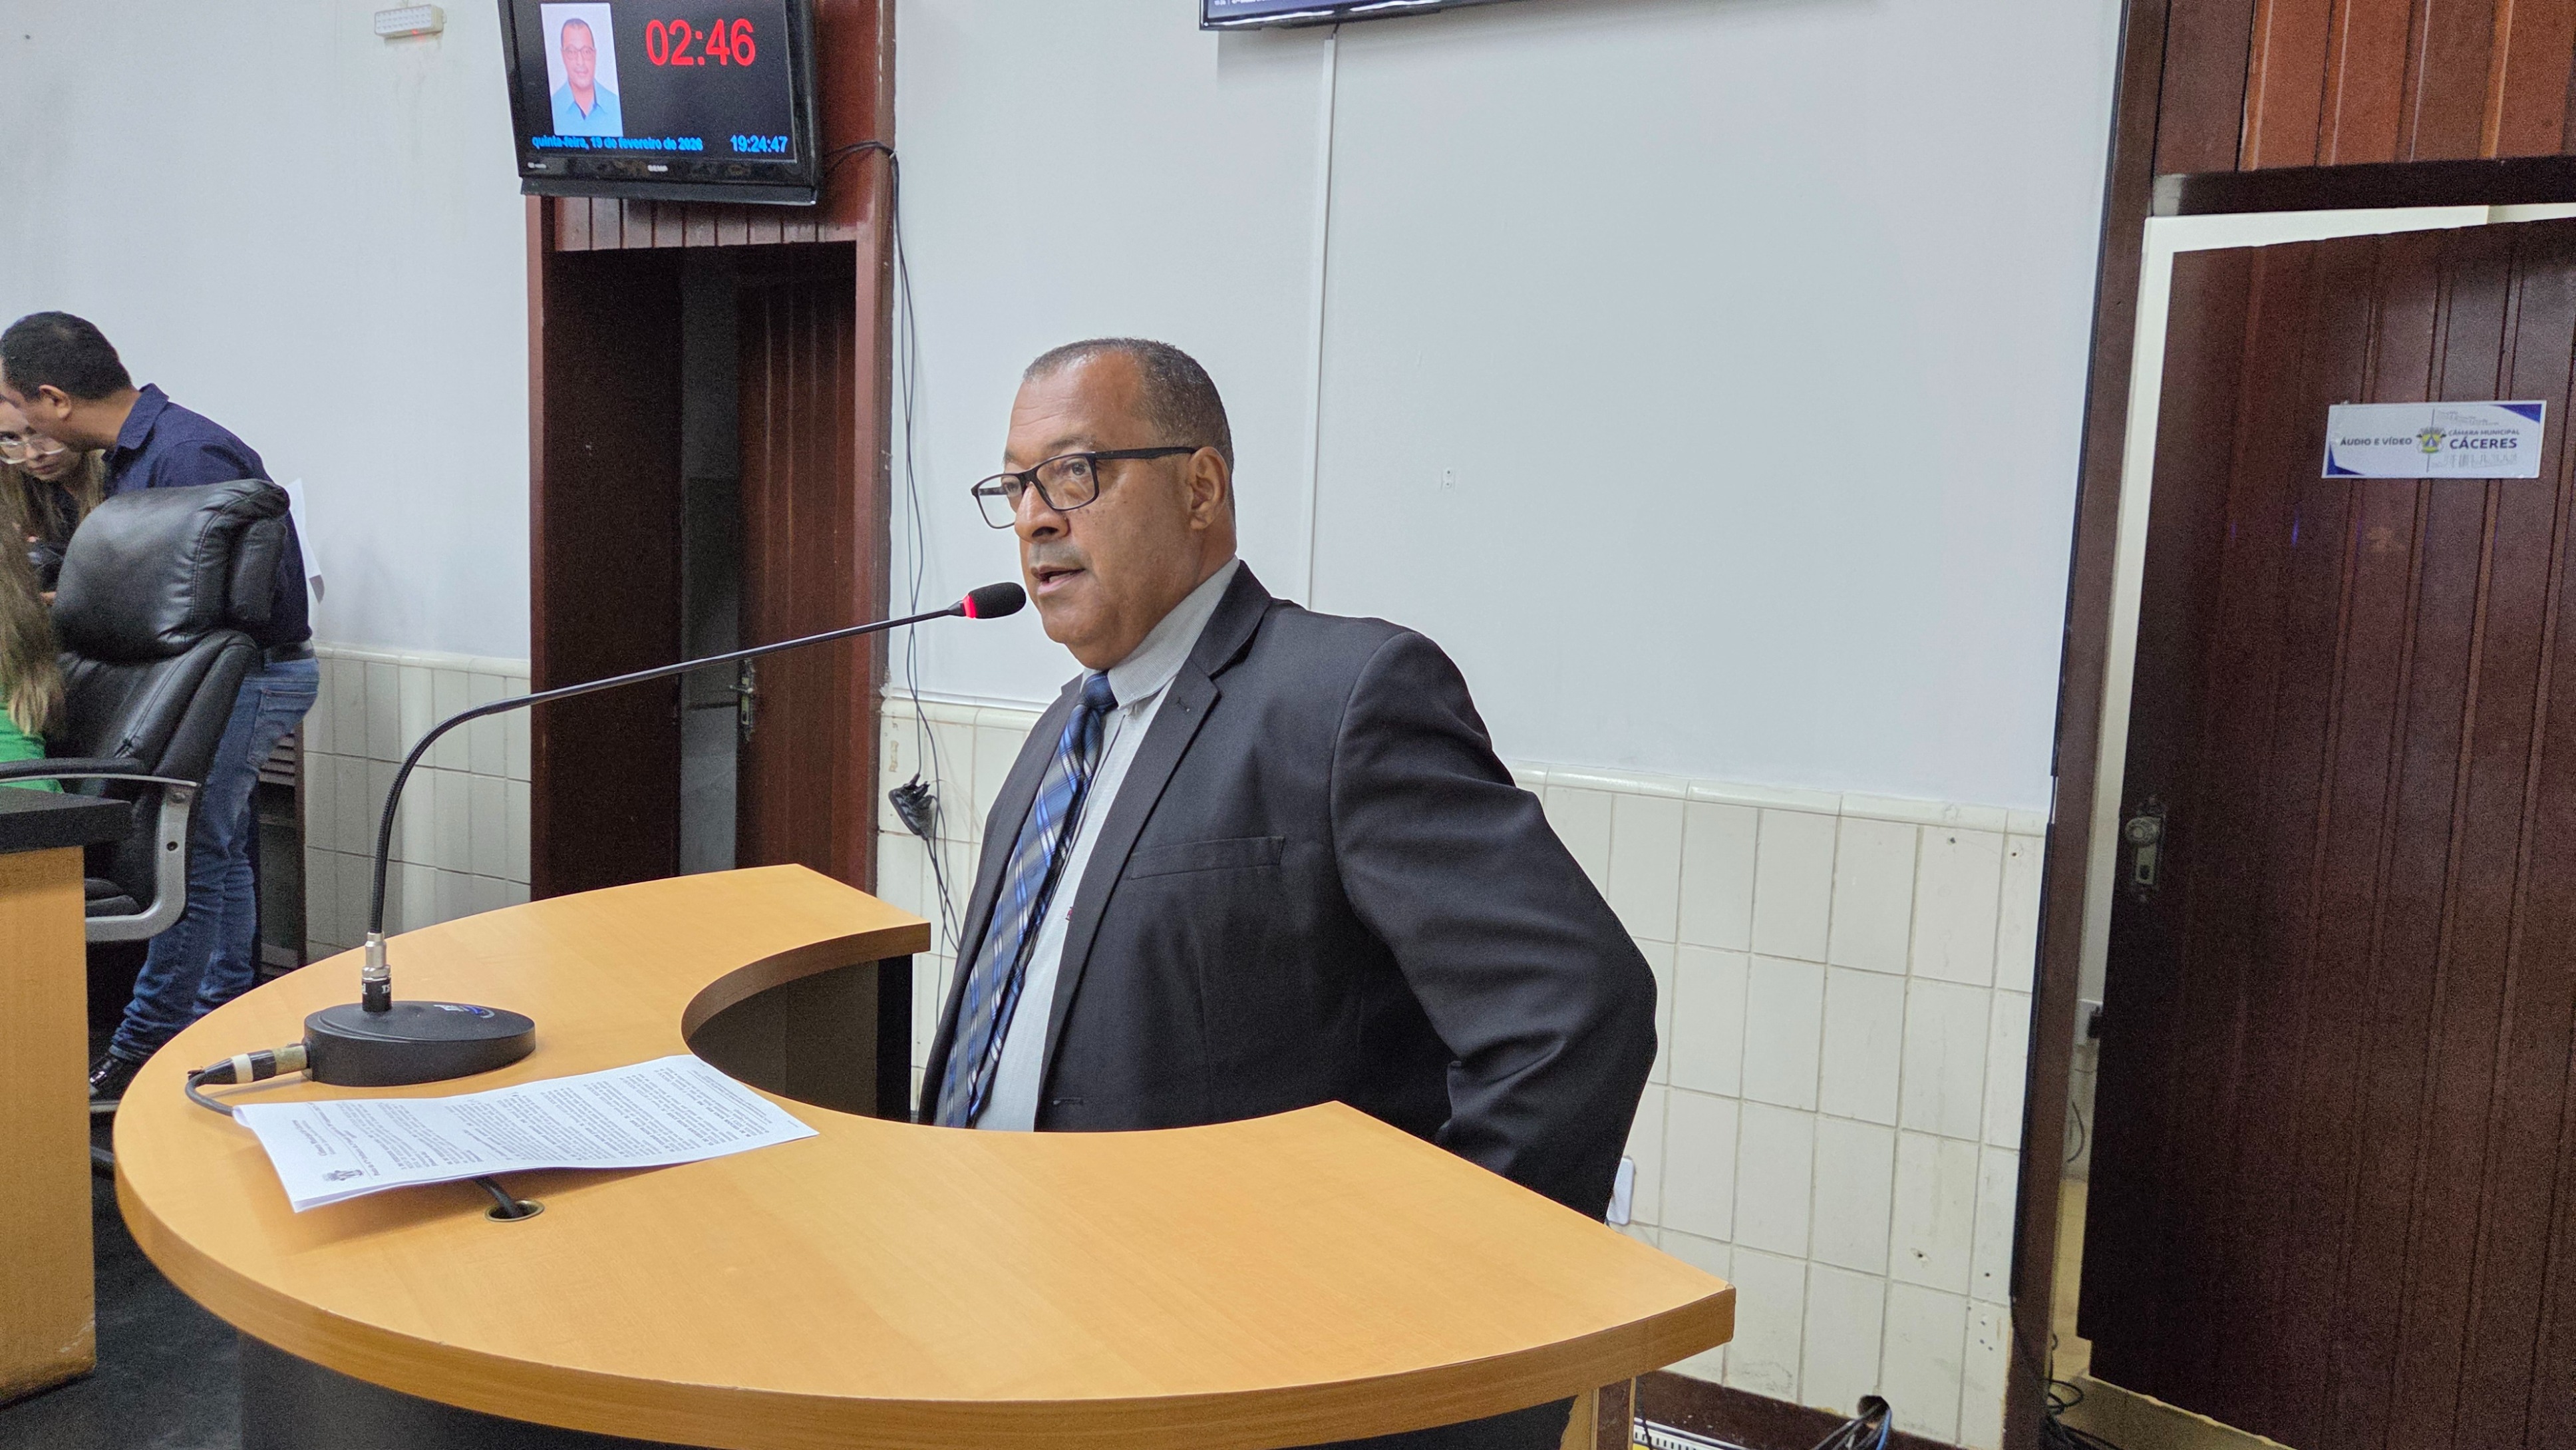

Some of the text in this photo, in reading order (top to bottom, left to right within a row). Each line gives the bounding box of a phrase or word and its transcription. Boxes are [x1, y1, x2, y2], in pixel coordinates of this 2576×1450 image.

[646, 18, 756, 67] 02:46
[730, 134, 788, 152] 19:24:47
[2340, 436, 2412, 446] ÁUDIO E VÍDEO
[2450, 436, 2517, 449] CÁCERES
